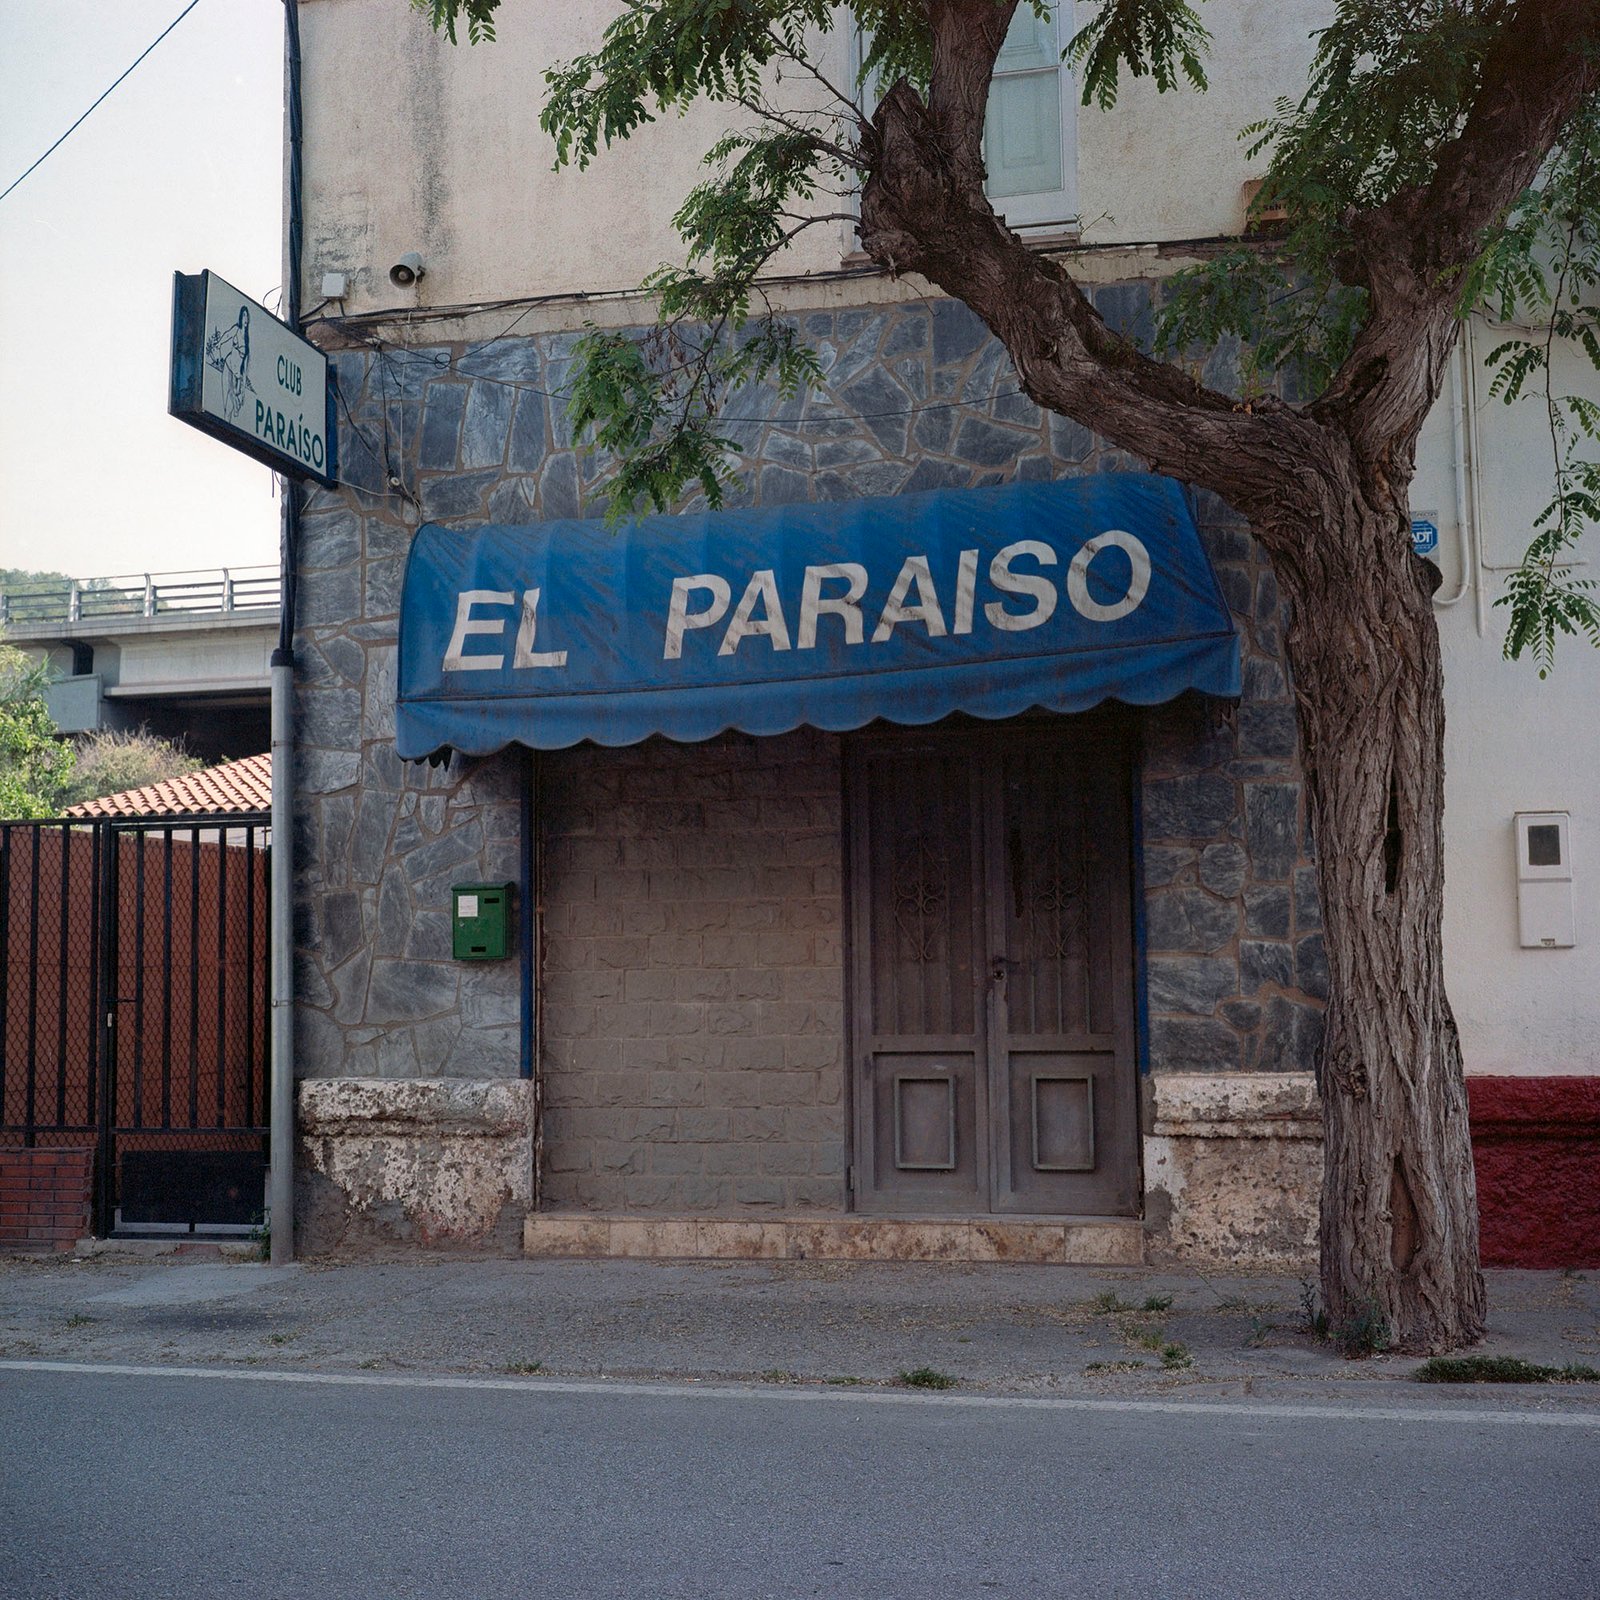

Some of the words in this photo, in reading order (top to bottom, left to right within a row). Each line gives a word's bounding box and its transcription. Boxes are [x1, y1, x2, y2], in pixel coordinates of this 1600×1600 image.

[277, 355, 302, 396] CLUB
[256, 399, 324, 469] PARAÍSO
[442, 587, 568, 672] EL
[663, 529, 1152, 660] PARAISO
